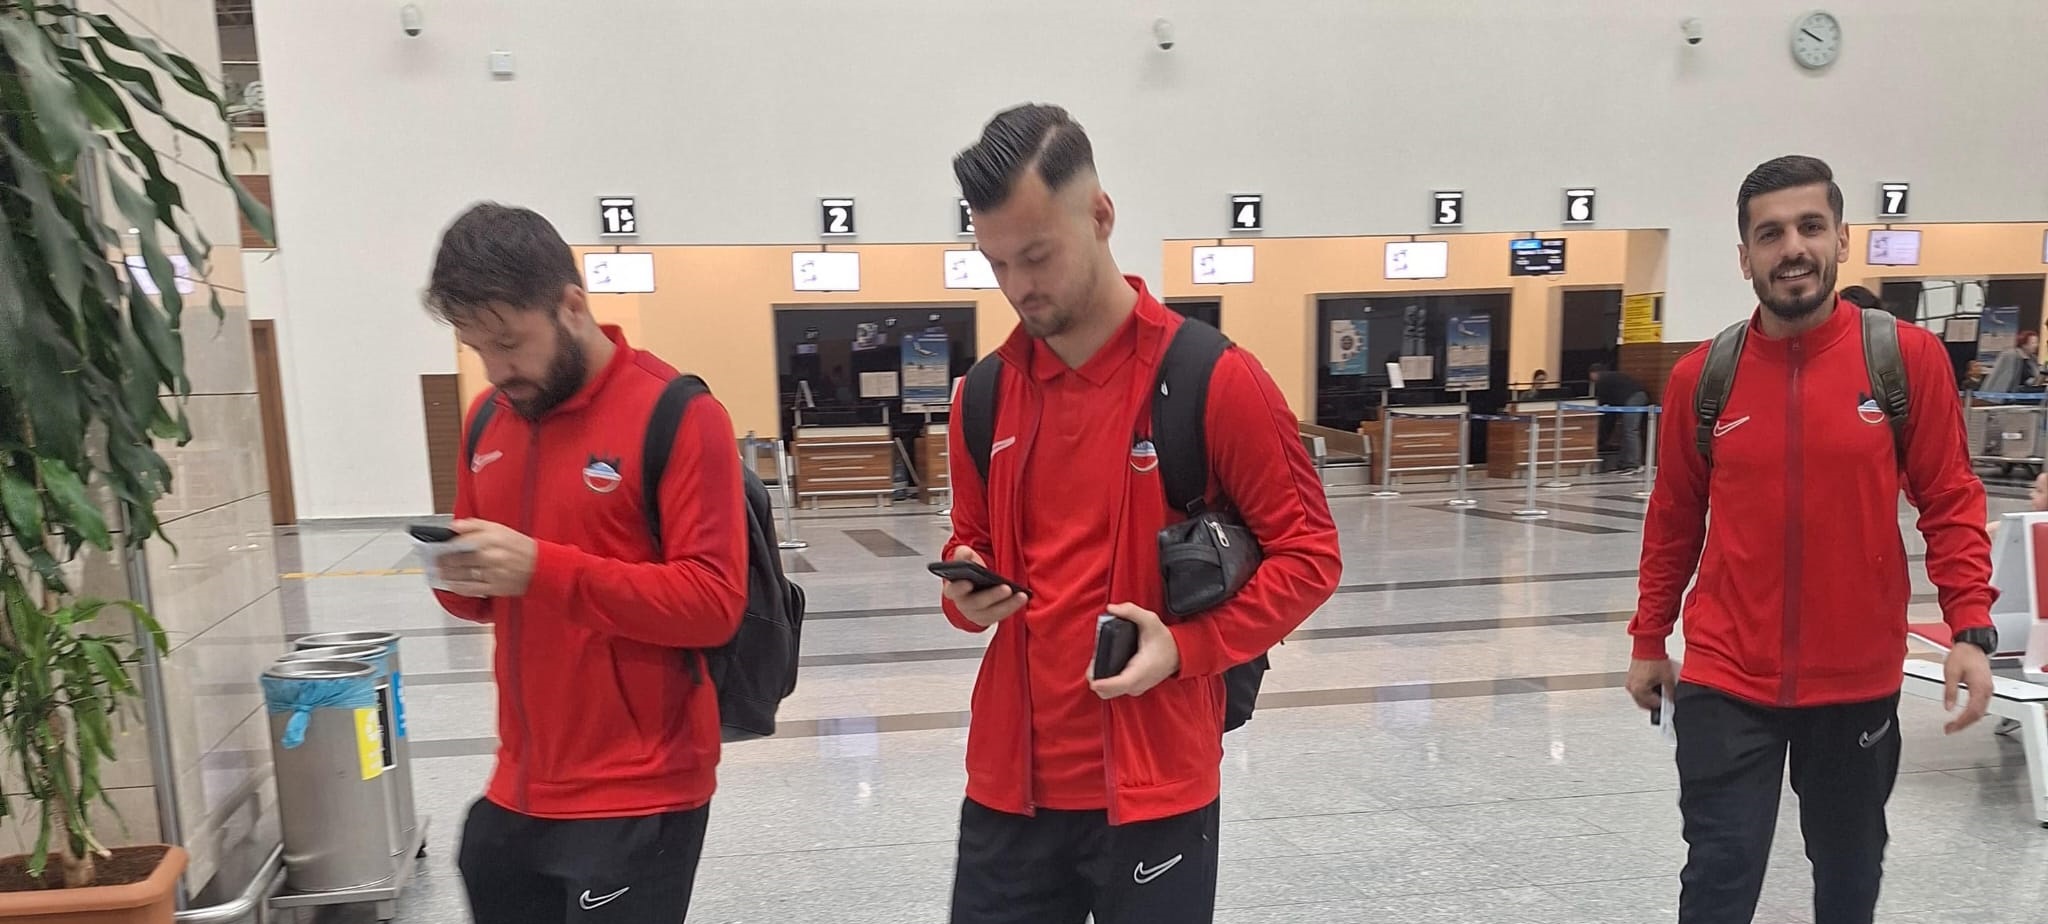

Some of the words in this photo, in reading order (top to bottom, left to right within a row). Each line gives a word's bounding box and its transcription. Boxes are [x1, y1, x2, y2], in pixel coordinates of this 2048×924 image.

[1440, 200, 1457, 223] 5
[1571, 197, 1589, 220] 6
[1886, 191, 1903, 213] 7
[829, 207, 849, 233] 2
[1237, 204, 1256, 227] 4
